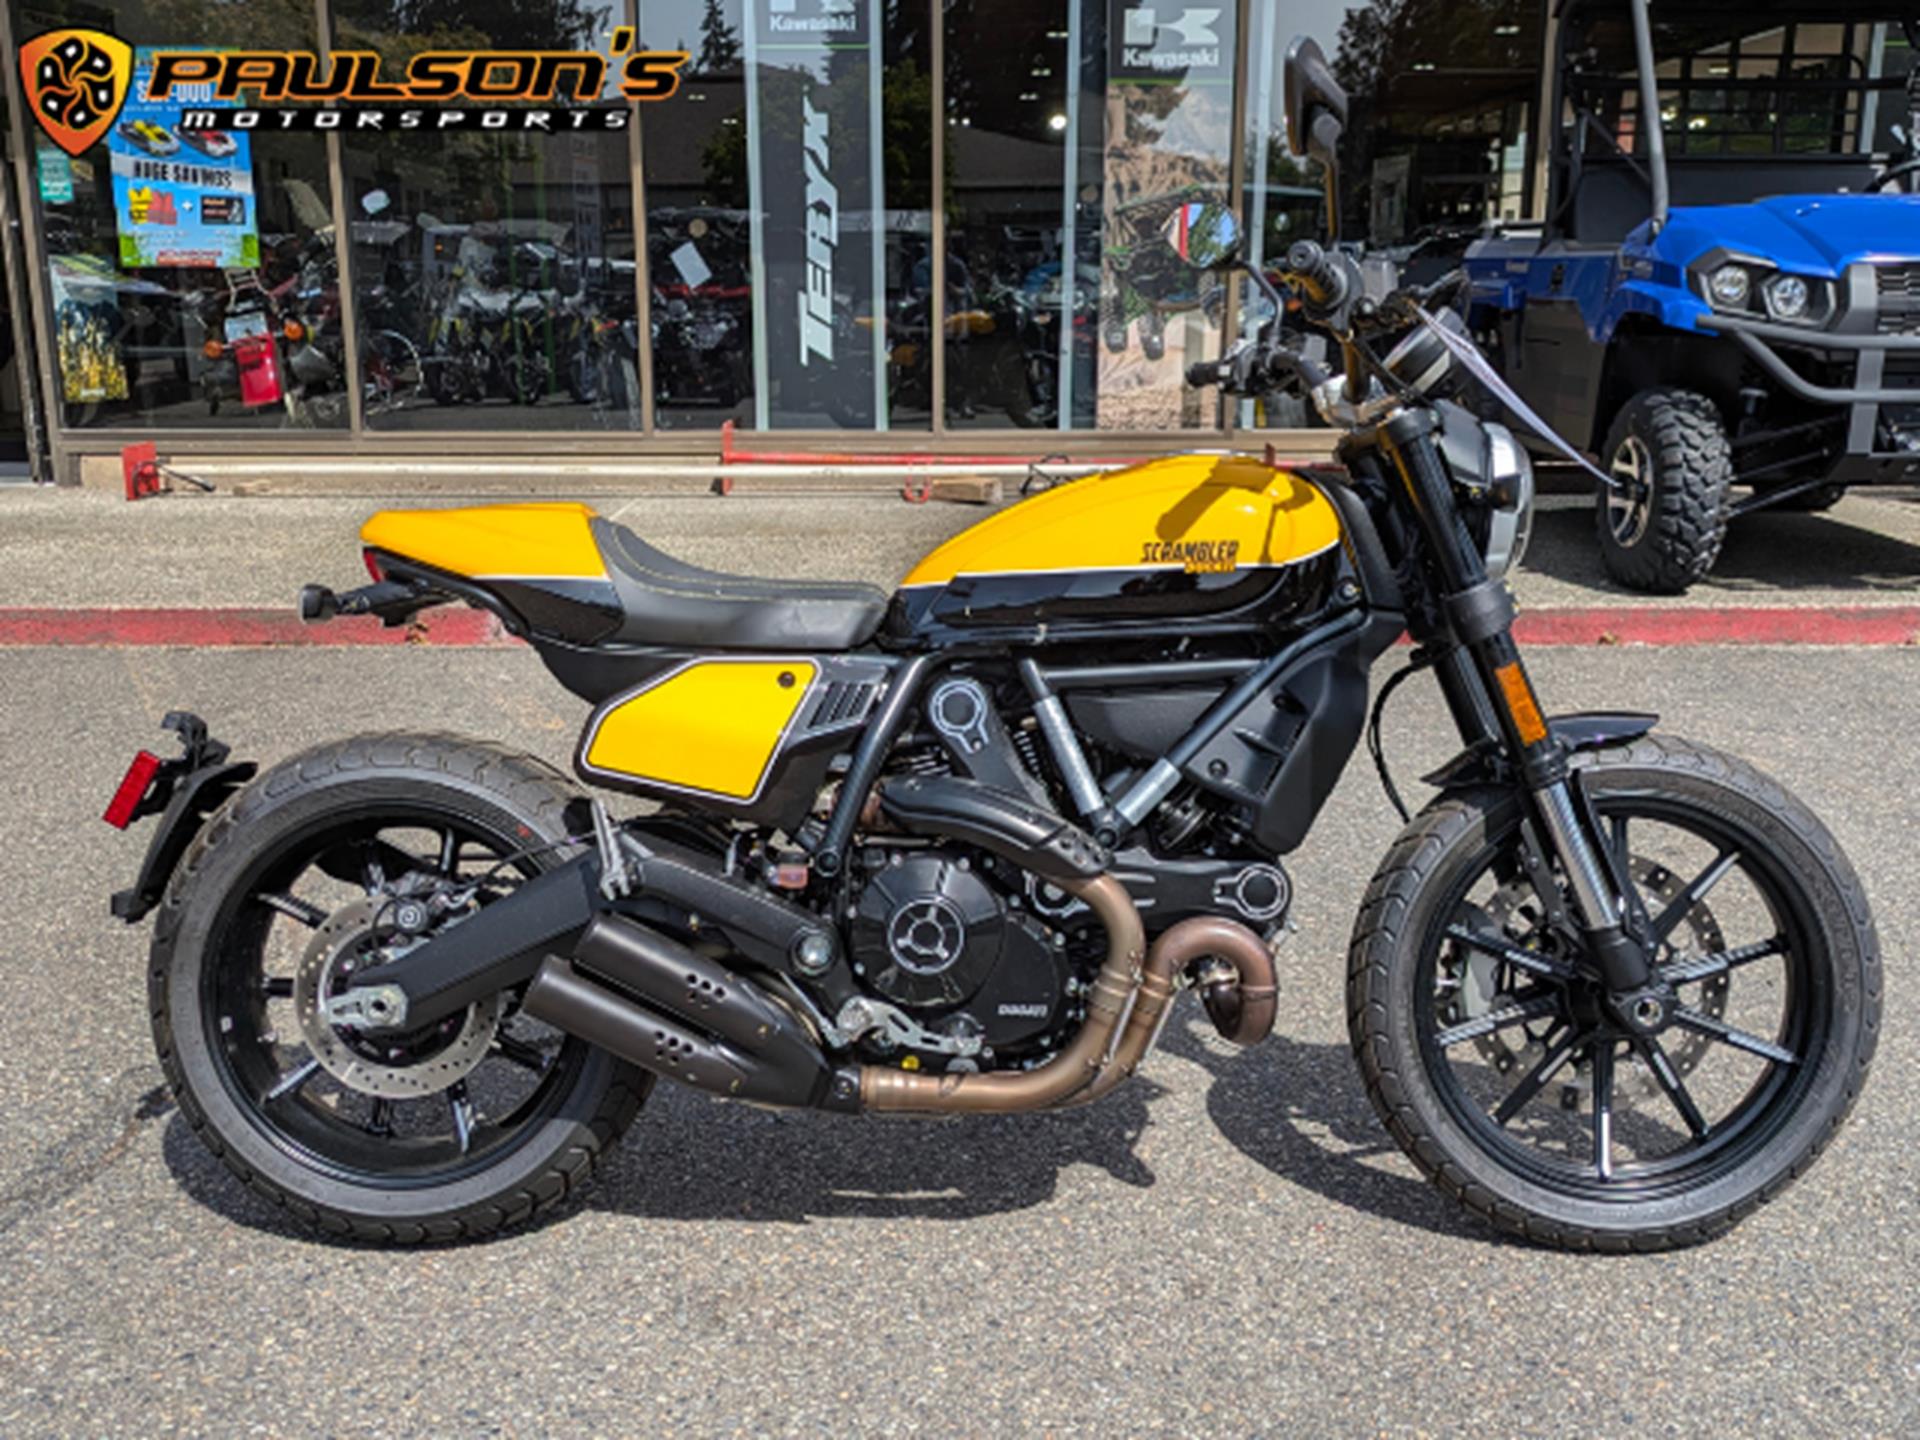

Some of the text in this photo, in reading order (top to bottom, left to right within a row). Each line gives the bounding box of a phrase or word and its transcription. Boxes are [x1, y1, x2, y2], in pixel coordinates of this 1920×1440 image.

[769, 15, 857, 31] Kawasaki
[1123, 48, 1219, 69] Kawasaki
[133, 160, 168, 181] HUGE
[798, 94, 838, 367] TERYX
[1141, 540, 1239, 563] SCRAMBLER
